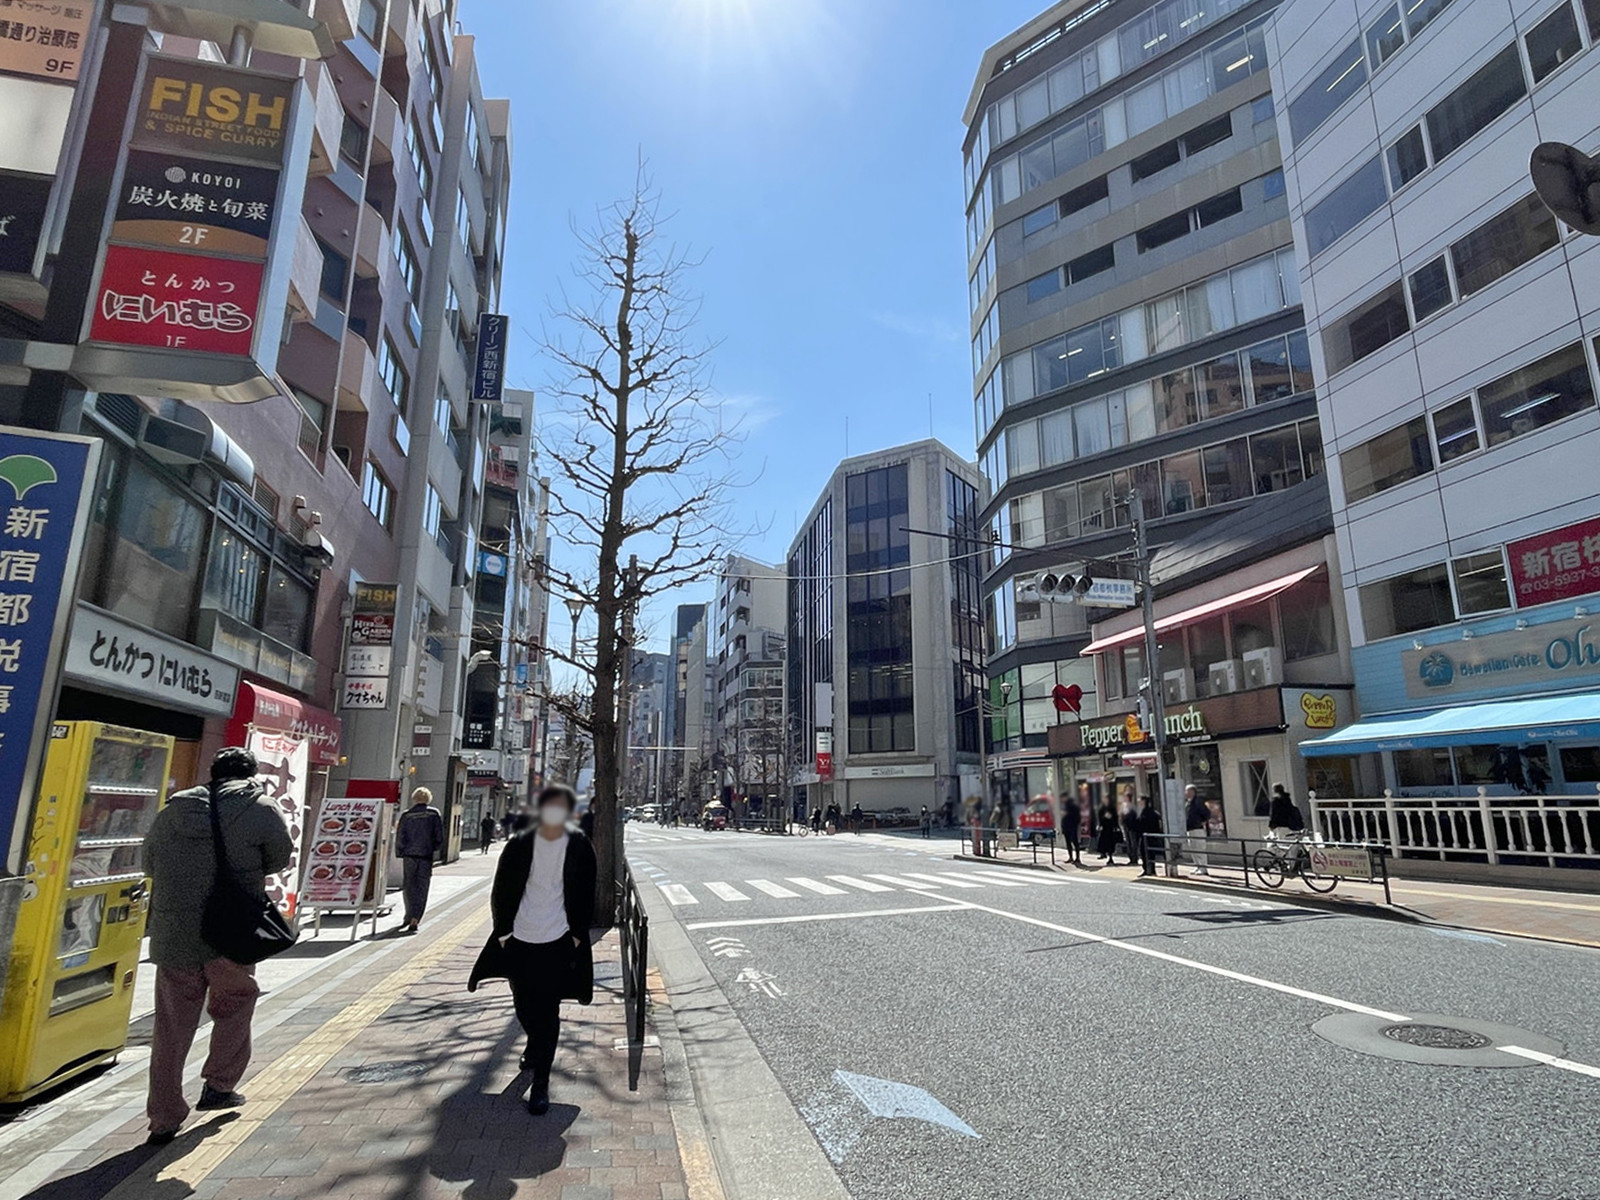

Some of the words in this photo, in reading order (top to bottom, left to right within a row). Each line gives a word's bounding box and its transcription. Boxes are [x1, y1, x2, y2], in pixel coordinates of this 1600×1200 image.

[45, 58, 74, 73] 9F
[150, 77, 286, 130] FISH
[146, 112, 191, 124] INDIAN
[195, 119, 241, 132] STREET
[144, 119, 157, 132] &
[164, 122, 215, 140] SPICE
[220, 131, 279, 149] CURRY
[191, 172, 241, 190] KOYOI
[127, 186, 270, 222] 炭火焼と旬菜
[179, 226, 209, 246] 2F
[140, 270, 236, 294] とんかつ
[102, 289, 253, 333] にいむら
[165, 334, 187, 348] 1F
[480, 317, 501, 399] クリーン西新宿ビル
[357, 588, 396, 602] FISH
[90, 630, 155, 679] とんかつ
[158, 653, 212, 698] にいむら
[346, 691, 385, 705] クマちゃん
[1080, 723, 1125, 747] Pepper
[326, 802, 350, 812] Lunch
[352, 803, 376, 813] Menu
